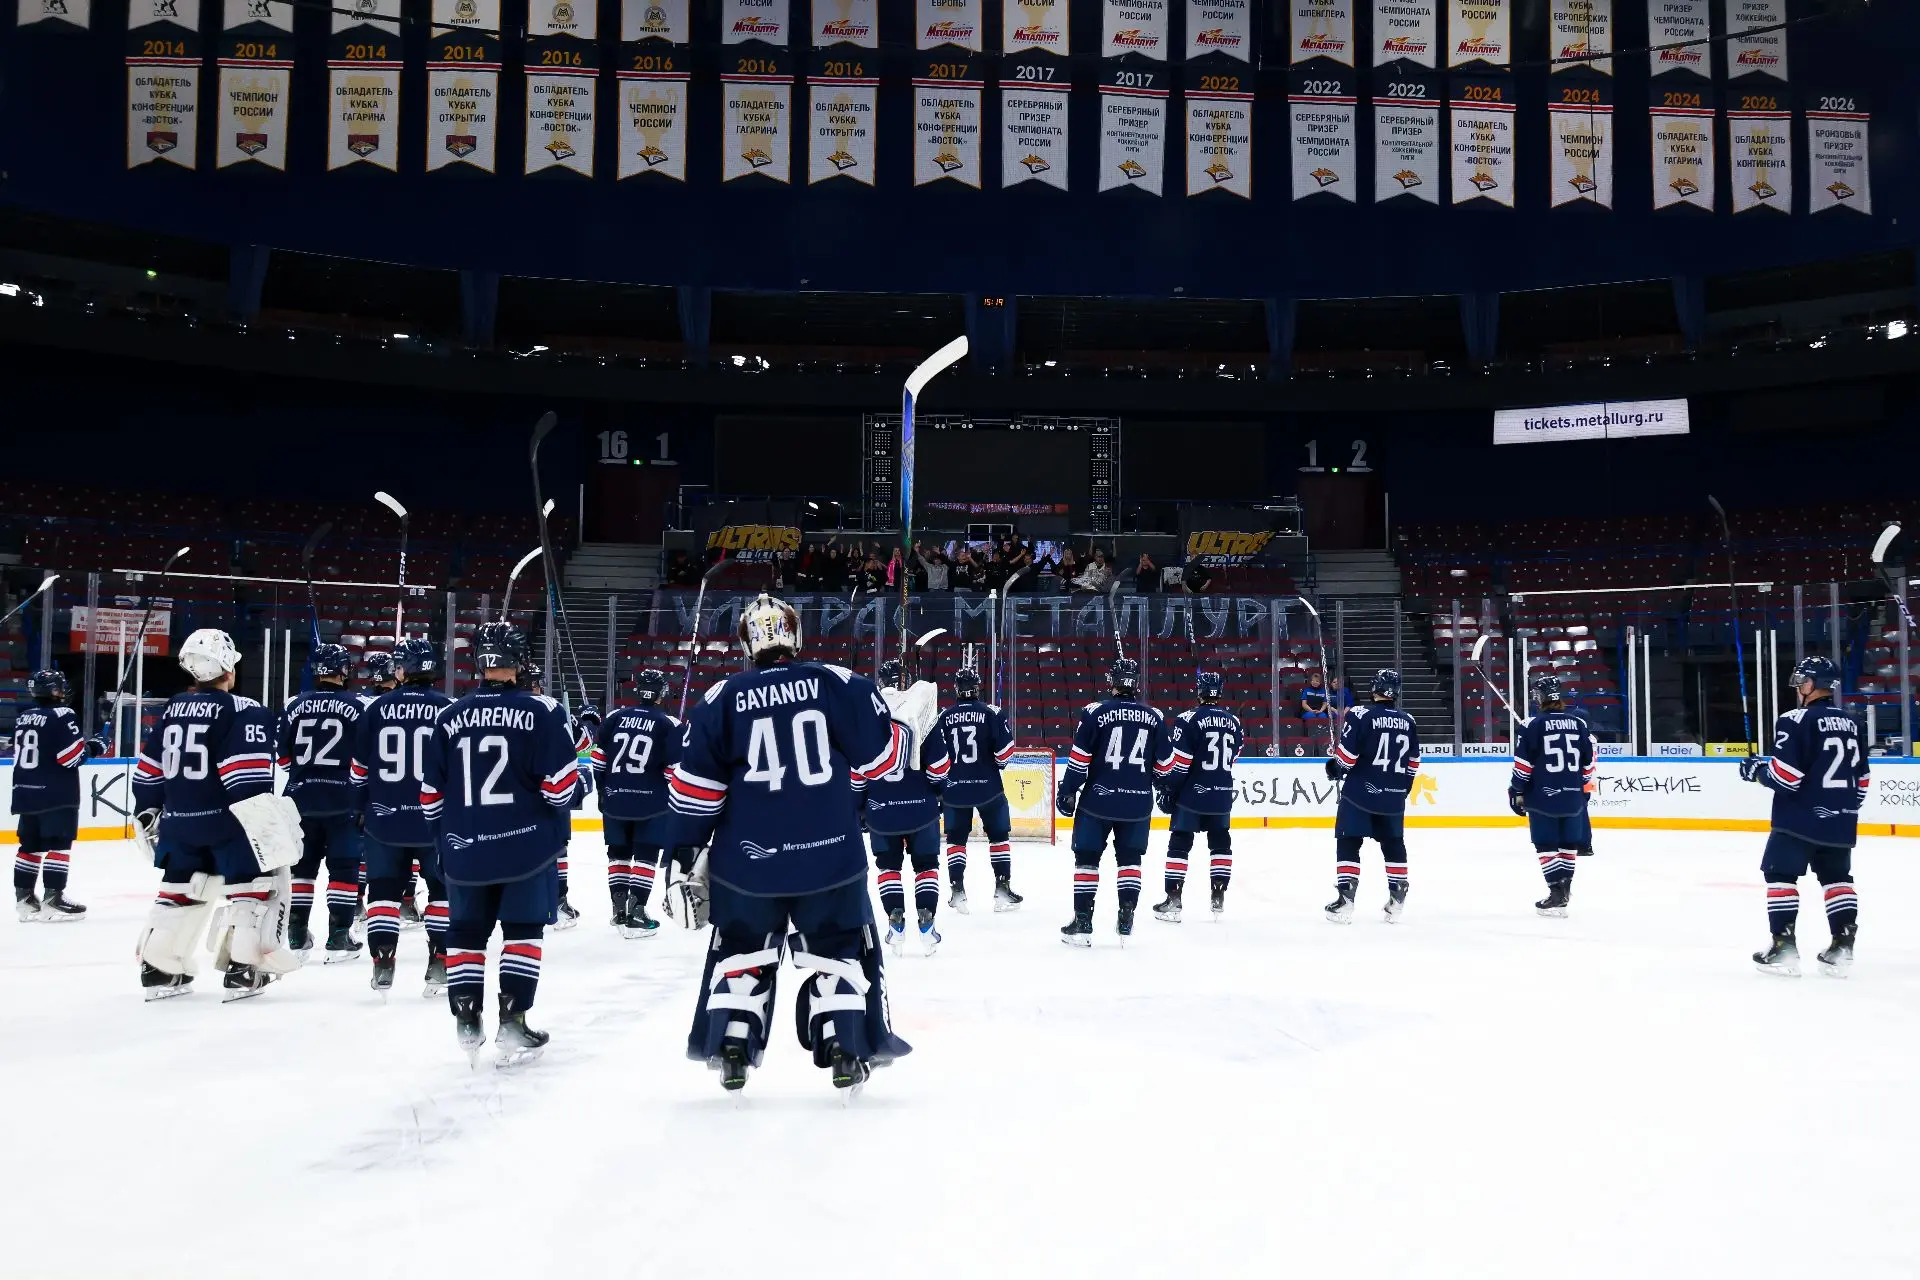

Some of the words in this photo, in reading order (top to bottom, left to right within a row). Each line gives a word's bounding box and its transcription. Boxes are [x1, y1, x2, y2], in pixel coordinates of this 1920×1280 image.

[1110, 0, 1162, 10] ЧЕМПИОНАТА
[1663, 4, 1692, 13] ПРИЗЕР
[1120, 12, 1152, 21] РОССИИ
[1202, 11, 1234, 20] РОССИИ
[1299, 9, 1345, 19] ШПЕНГЛЕРА
[1379, 6, 1430, 16] ЧЕМПИОНАТА
[1462, 10, 1496, 20] РОССИИ
[1389, 18, 1420, 27] РОССИИ
[1654, 16, 1704, 26] ЧЕМПИОНАТА
[1664, 28, 1694, 37] РОССИИ
[144, 41, 184, 56] 2014
[235, 44, 276, 58] 2014
[346, 44, 386, 60] 2014
[444, 45, 484, 61] 2014
[542, 51, 582, 66] 2016
[634, 56, 673, 70] 2016
[738, 60, 776, 74] 2016
[824, 62, 862, 76] 2016
[928, 64, 968, 78] 2017
[1016, 66, 1054, 81] 2017
[135, 76, 191, 87] ОБЛАДАТЕЛЬ
[1116, 72, 1153, 87] 2017
[1200, 76, 1239, 90] 2022
[336, 86, 393, 97] ОБЛАДАТЕЛЬ
[435, 86, 491, 97] ОБЛАДАТЕЛЬ
[534, 85, 589, 95] ОБЛАДАТЕЛЬ
[1303, 81, 1341, 95] 2022
[1388, 83, 1425, 97] 2022
[1464, 86, 1501, 100] 2024
[150, 90, 177, 100] КУБКА
[230, 91, 278, 103] ЧЕМПИОН
[1563, 89, 1600, 103] 2024
[1664, 93, 1700, 105] 2024
[132, 102, 194, 113] КОНФЕРЕНЦИИ
[350, 99, 378, 110] КУБКА
[448, 100, 476, 110] КУБКА
[547, 98, 575, 108] КУБКА
[629, 103, 676, 114] ЧЕМПИОН
[729, 100, 784, 110] ОБЛАДАТЕЛЬ
[815, 102, 870, 112] ОБЛАДАТЕЛЬ
[921, 99, 974, 109] ОБЛАДАТЕЛЬ
[1007, 99, 1062, 111] СЕРЕБРЯНЫЙ
[1742, 97, 1776, 109] 2026
[1820, 98, 1855, 110] 2026
[233, 105, 273, 117] РОССИИ
[530, 110, 592, 121] КОНФЕРЕНЦИИ
[934, 111, 961, 120] КУБКА
[1107, 105, 1160, 117] СЕРЕБРЯНЫЙ
[1192, 109, 1244, 119] ОБЛАДАТЕЛЬ
[342, 112, 385, 123] ГАГАРИНА
[439, 112, 486, 123] ОТКРЫТИЯ
[633, 117, 672, 128] РОССИИ
[743, 113, 771, 122] КУБКА
[829, 115, 856, 125] КУБКА
[1019, 112, 1051, 123] ПРИЗЕР
[1119, 118, 1148, 128] ПРИЗЕР
[1296, 113, 1350, 123] СЕРЕБРЯНЫЙ
[1380, 116, 1434, 125] СЕРЕБРЯНЫЙ
[736, 125, 778, 135] ГАГАРИНА
[917, 124, 978, 134] КОНФЕРЕНЦИИ
[1008, 125, 1062, 136] ЧЕМПИОНАТА
[1205, 121, 1231, 131] КУБКА
[1307, 124, 1338, 133] ПРИЗЕР
[1457, 120, 1508, 130] ОБЛАДАТЕЛЬ
[819, 126, 865, 137] ОТКРЫТИЯ
[1392, 127, 1422, 135] ПРИЗЕР
[1018, 137, 1051, 147] РОССИИ
[1189, 134, 1248, 144] КОНФЕРЕНЦИИ
[1296, 137, 1350, 146] ЧЕМПИОНАТА
[1470, 133, 1496, 141] КУБКА
[1560, 135, 1603, 145] ЧЕМПИОН
[1657, 133, 1708, 142] ОБЛАДАТЕЛЬ
[1735, 136, 1785, 145] ОБЛАДАТЕЛЬ
[1454, 144, 1511, 155] КОНФЕРЕНЦИИ
[1670, 145, 1696, 153] КУБКА
[1824, 142, 1853, 150] ПРИЗЕР
[1308, 148, 1340, 156] РОССИИ
[1564, 148, 1600, 158] РОССИИ
[1748, 148, 1773, 156] КУБКА
[1664, 157, 1702, 165] ГАГАРИНА
[1736, 159, 1785, 168] КОНТИНЕНТА
[984, 298, 1003, 306] 15:19
[1524, 411, 1663, 431] tickets.metallurg.ru
[597, 431, 628, 458] 16
[656, 432, 668, 458] 1
[1305, 440, 1316, 466] 1
[1352, 440, 1367, 466] 2
[422, 661, 433, 671] 90
[486, 654, 497, 668] 12
[1124, 678, 1132, 687] 44
[736, 678, 819, 713] GAYANOV
[443, 706, 534, 739] MAKARENKO
[619, 716, 655, 732] ZHULIN
[1545, 719, 1578, 732] AFONIN
[245, 724, 266, 742] 85
[295, 719, 343, 766] 52
[951, 726, 978, 763] 13
[15, 730, 39, 769] 58
[162, 724, 210, 780] 85
[378, 726, 434, 782] 90
[611, 732, 653, 774] 29
[744, 710, 833, 792] 40
[1105, 726, 1149, 772] 44
[1202, 732, 1234, 771] 36
[1373, 732, 1410, 773] 42
[1464, 746, 1507, 754] KHL.RU
[1544, 734, 1580, 772] 55
[1660, 745, 1692, 755] Haier
[457, 736, 514, 807] 12
[477, 825, 538, 842] Металлоинвест
[783, 834, 846, 852] Металлоинвест
